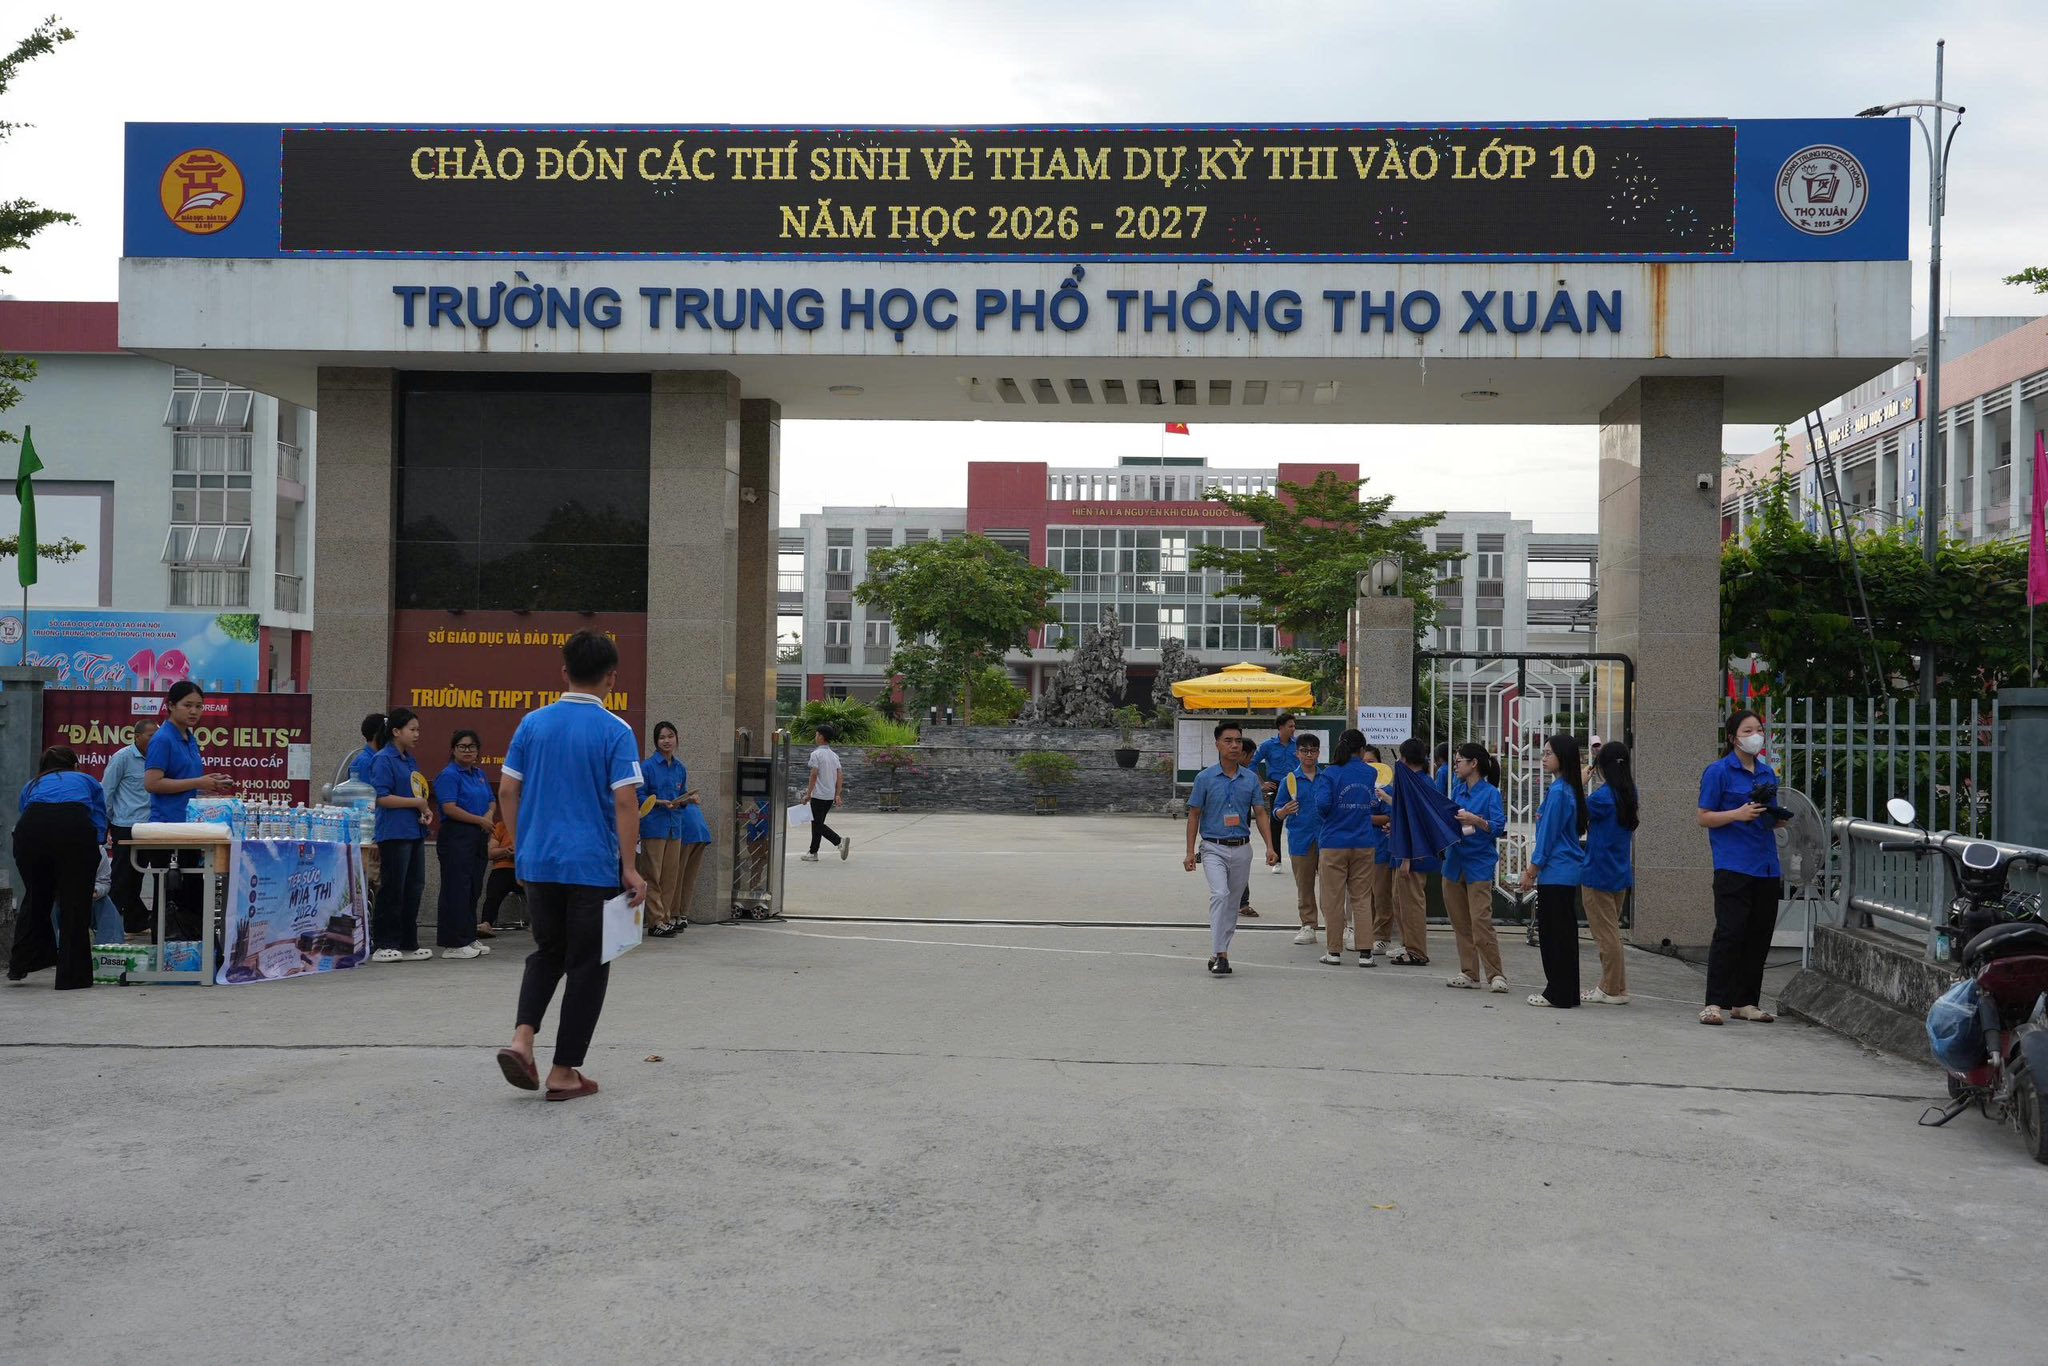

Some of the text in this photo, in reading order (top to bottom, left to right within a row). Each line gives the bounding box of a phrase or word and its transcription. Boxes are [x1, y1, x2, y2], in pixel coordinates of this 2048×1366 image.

[410, 138, 1596, 187] CHÀO ĐÓN CÁC THÍ SINH VỀ THAM DỰ KỲ THI VÀO LỚP 10
[1794, 206, 1848, 218] THỌ XUÂN
[779, 199, 877, 238] NĂM
[888, 206, 976, 246] HỌC
[987, 206, 1079, 240] 2026
[1115, 206, 1207, 240] 2027
[393, 271, 622, 330] TRƯỜNG
[640, 288, 825, 331] TRUNG
[841, 288, 958, 342] HỌC
[976, 264, 1089, 332] PHỔ
[1107, 278, 1302, 333] THÔNG
[428, 626, 445, 645] SỞ
[447, 627, 477, 645] GIÁO
[479, 632, 503, 648] DỤC
[506, 629, 522, 646] VÀ
[524, 629, 549, 646] ĐÀO
[133, 702, 158, 712] Dream
[411, 683, 484, 709] TRƯỜNG
[488, 690, 533, 711] THPT
[538, 691, 561, 711] TH
[1378, 711, 1394, 720] VỰC
[201, 756, 231, 767] APPLE
[233, 757, 258, 768] CAO
[260, 752, 284, 768] CẤP
[242, 779, 264, 789] KHO
[266, 780, 290, 790] 1.000
[313, 882, 332, 902] THI
